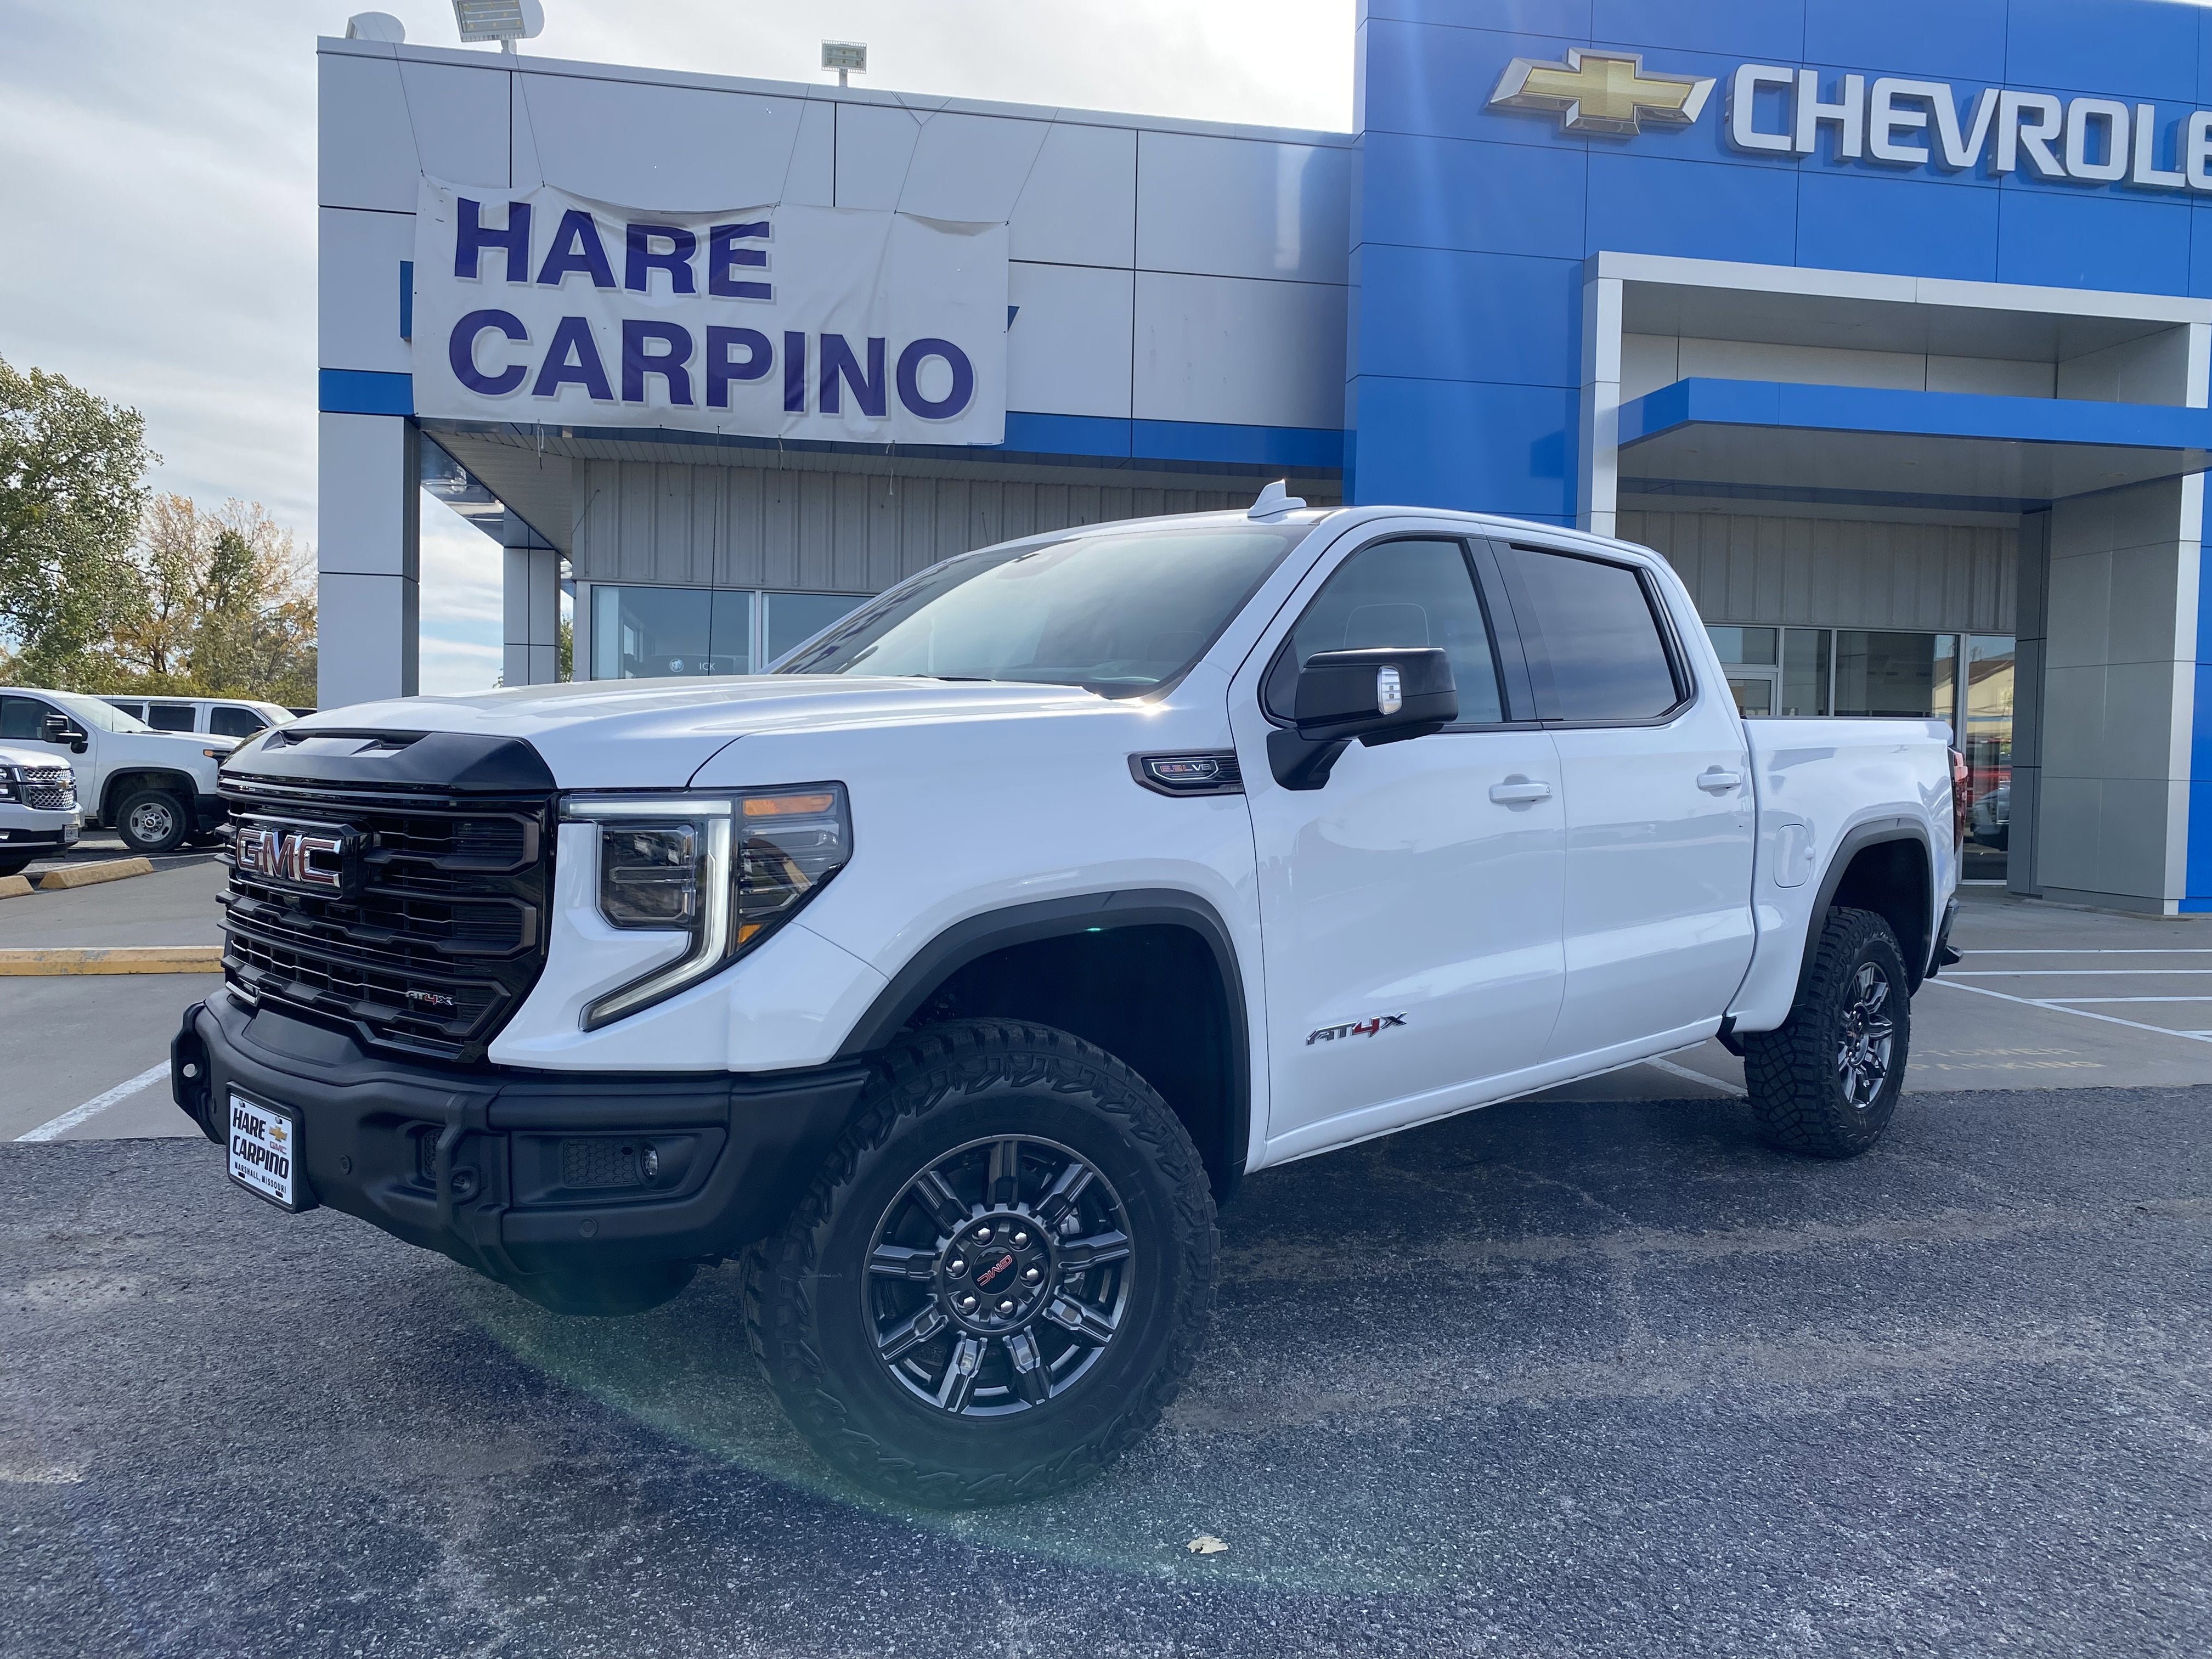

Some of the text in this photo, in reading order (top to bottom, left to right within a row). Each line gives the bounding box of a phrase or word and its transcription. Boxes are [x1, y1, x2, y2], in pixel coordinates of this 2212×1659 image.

[454, 197, 774, 302] HARE
[448, 309, 975, 420] CARPINO
[236, 827, 342, 888] GMC
[405, 990, 455, 1006] AT4X
[1305, 1011, 1408, 1046] AT4X
[233, 1107, 267, 1141] HARE
[233, 1135, 290, 1180] CARPINO
[269, 1141, 287, 1155] GMC
[262, 1175, 286, 1194] MISSOURI
[977, 1254, 1013, 1286] GMC
